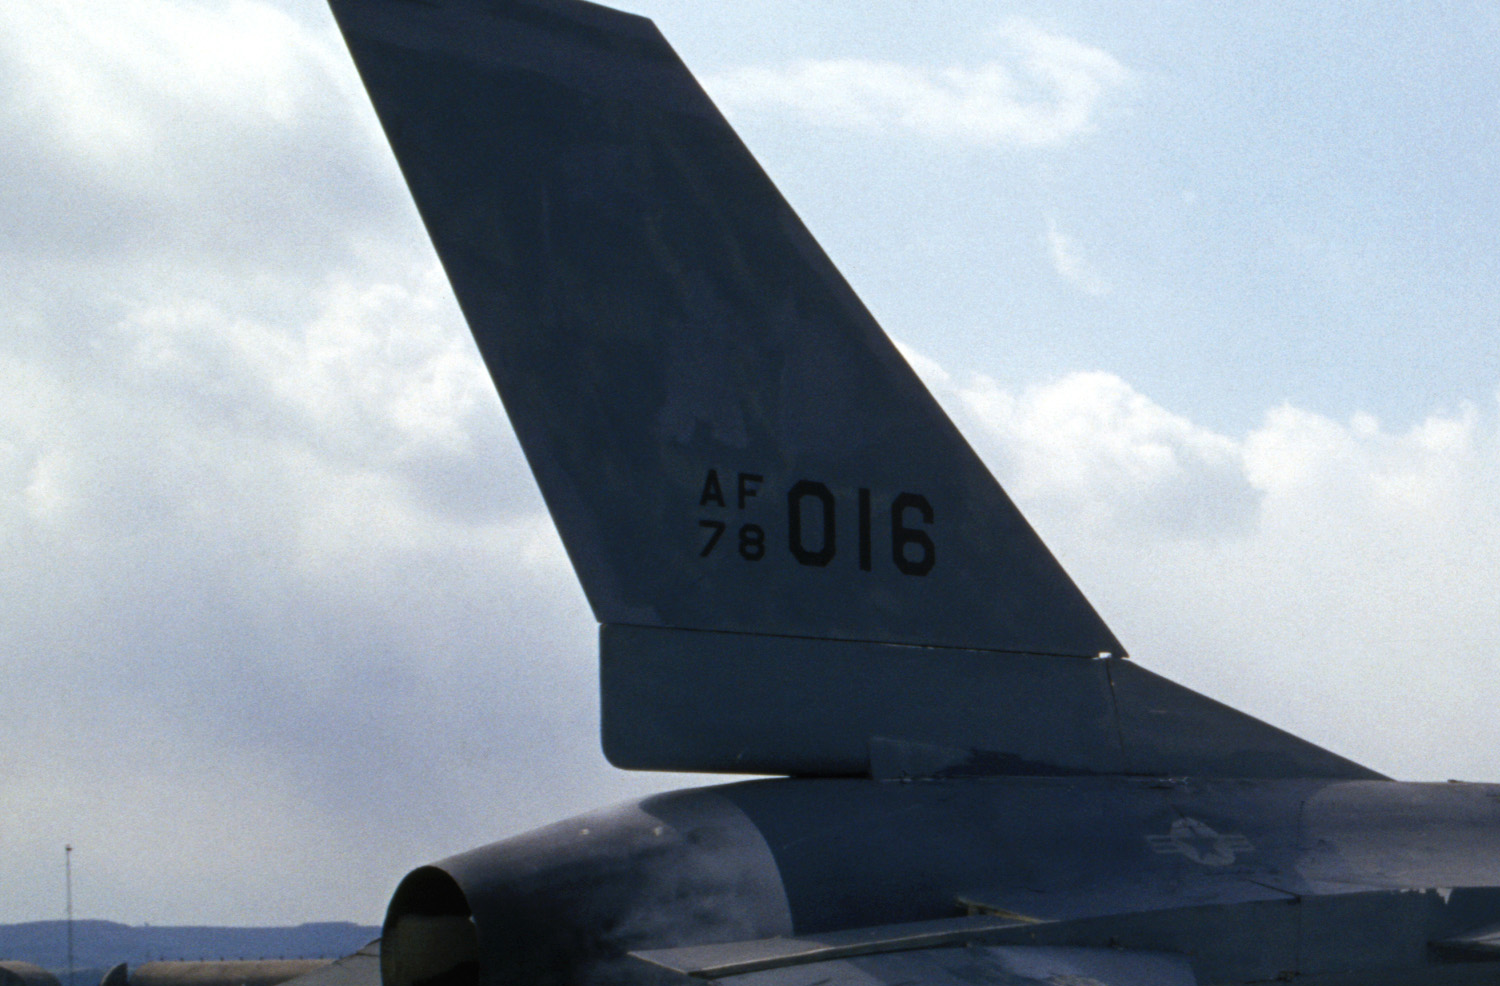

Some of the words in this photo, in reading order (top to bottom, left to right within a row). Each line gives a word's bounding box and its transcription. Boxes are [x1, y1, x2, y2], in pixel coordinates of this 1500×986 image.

[700, 468, 763, 510] AF
[699, 519, 765, 562] 78
[787, 479, 936, 577] 016
